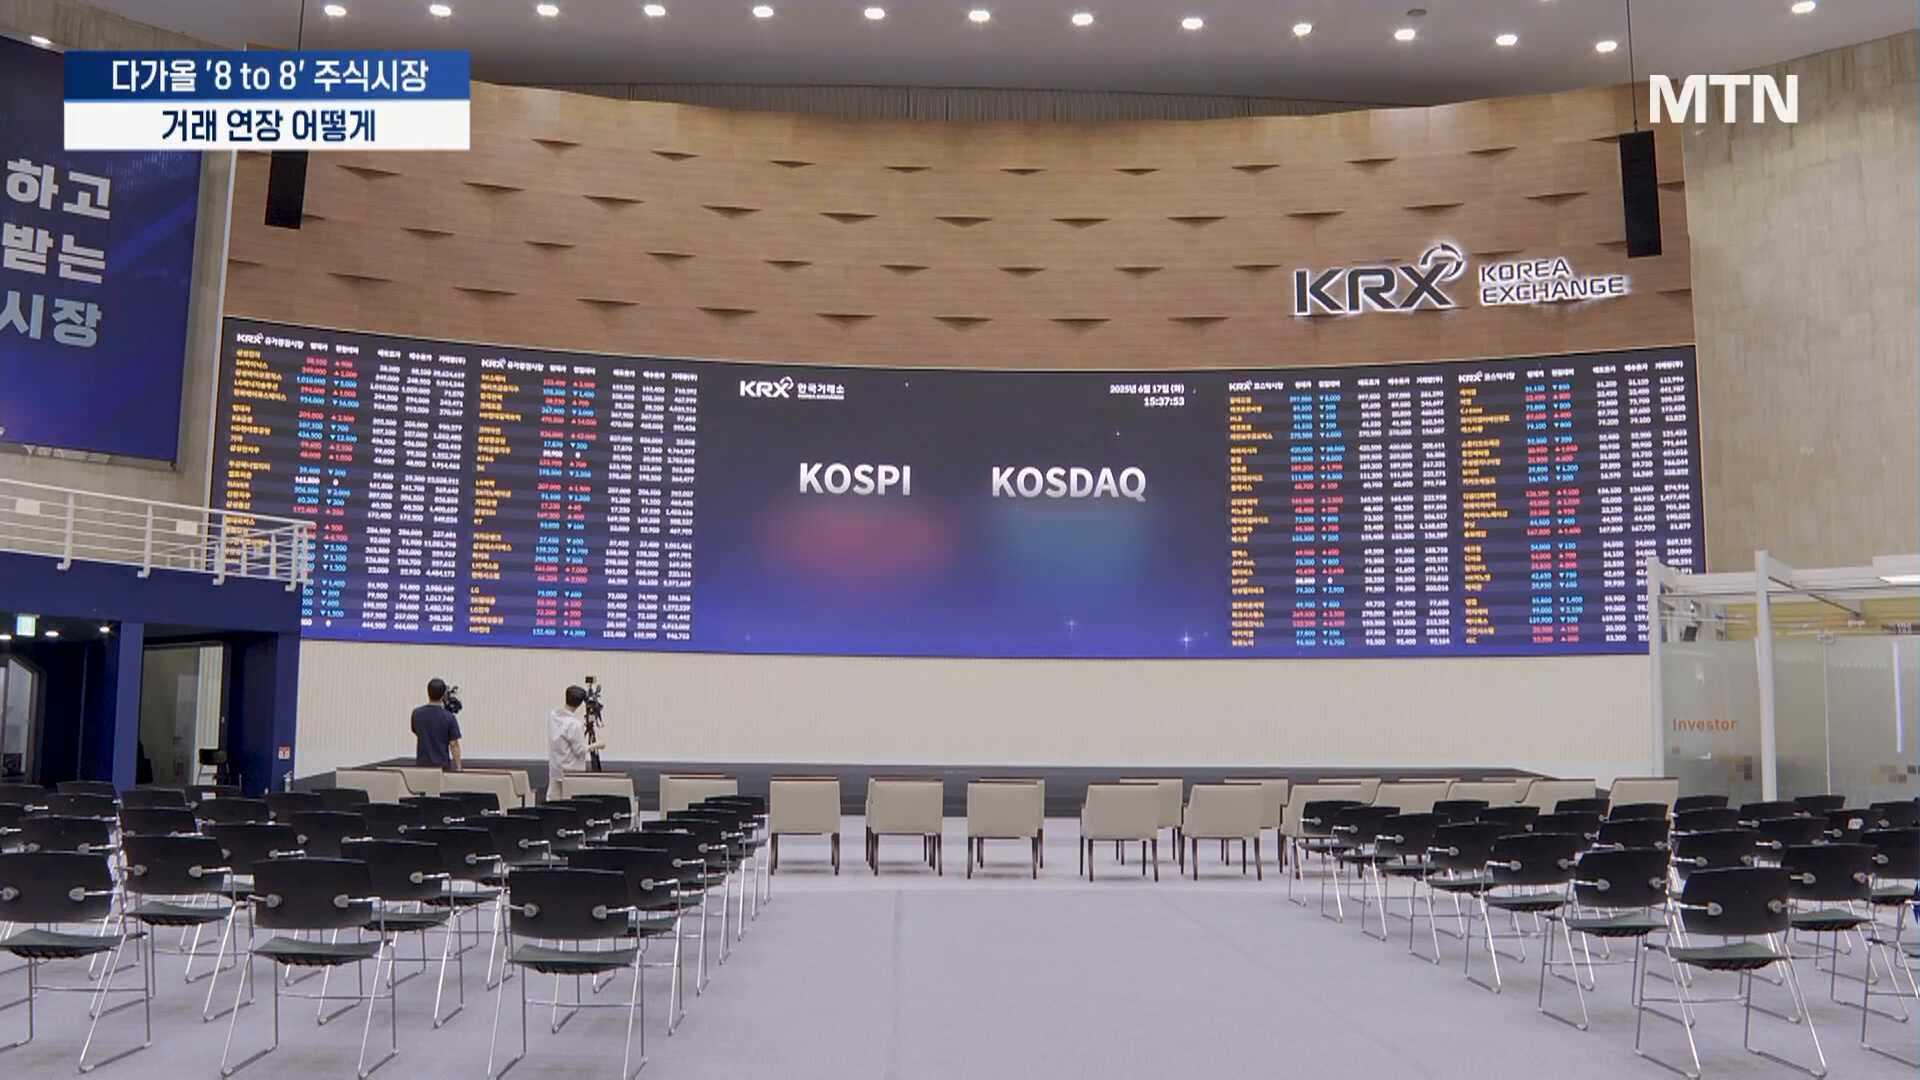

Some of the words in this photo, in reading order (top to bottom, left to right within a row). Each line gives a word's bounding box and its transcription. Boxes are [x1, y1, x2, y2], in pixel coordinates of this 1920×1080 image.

[6, 158, 111, 220] 하고
[1, 222, 106, 284] 받는
[1294, 245, 1464, 315] KRX
[1480, 257, 1570, 284] KOREA
[1481, 276, 1626, 305] EXCHANGE
[0, 290, 103, 348] 시장
[236, 332, 264, 344] KRX
[739, 376, 793, 399] KRX
[1229, 380, 1253, 391] KRX
[799, 462, 912, 496] KOSPI
[991, 466, 1147, 503] KOSDAQ
[1672, 718, 1738, 732] Investor
